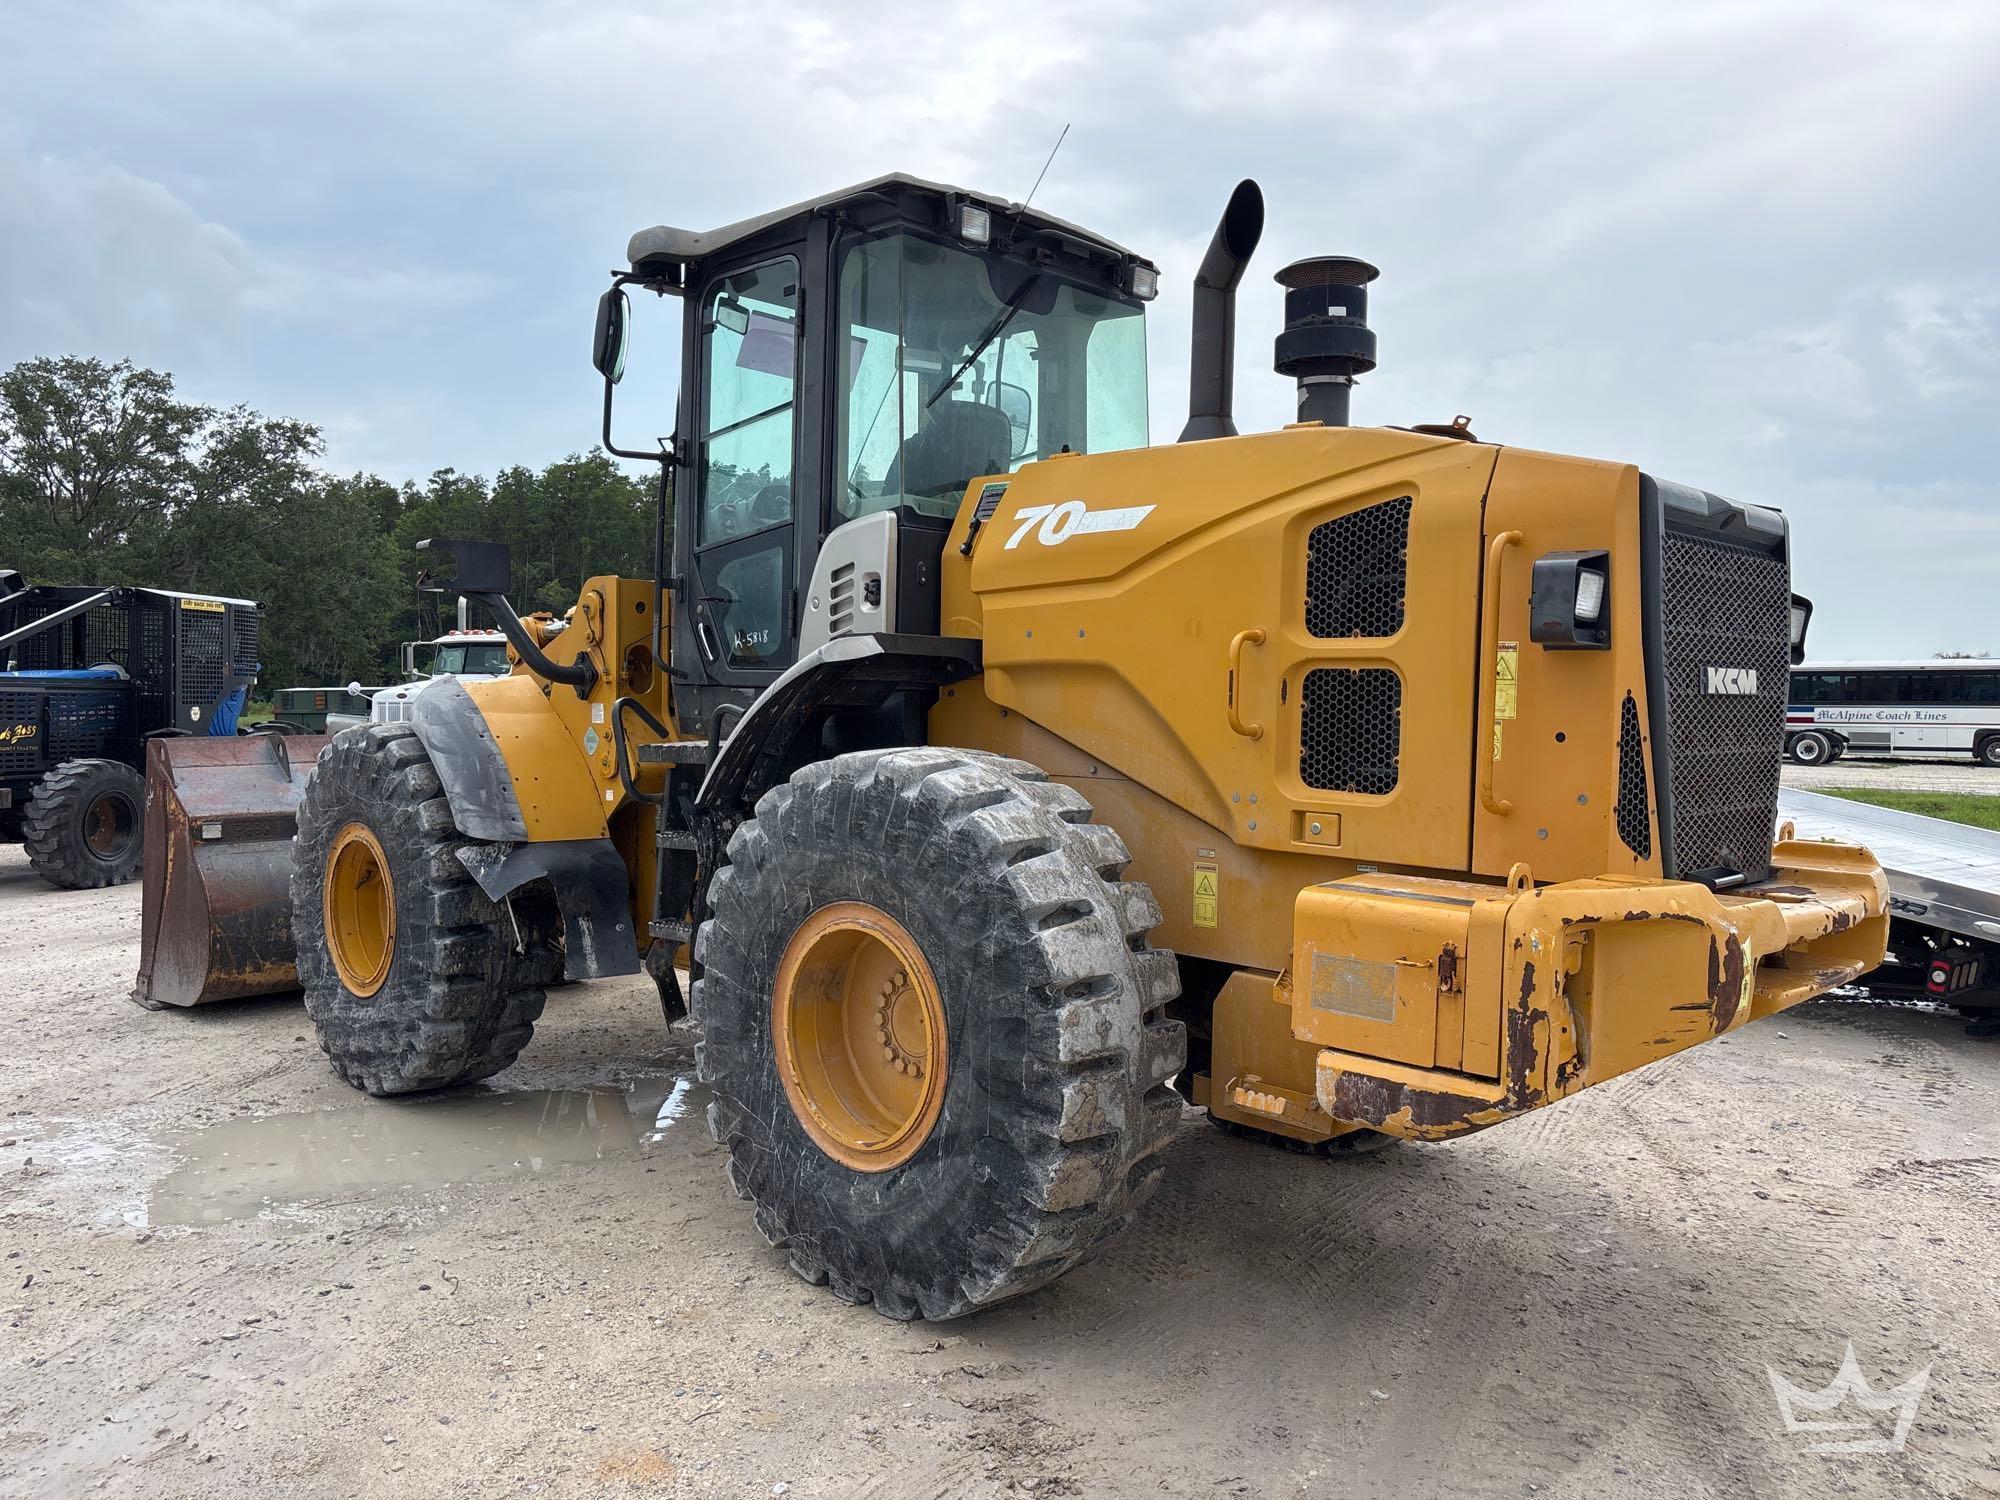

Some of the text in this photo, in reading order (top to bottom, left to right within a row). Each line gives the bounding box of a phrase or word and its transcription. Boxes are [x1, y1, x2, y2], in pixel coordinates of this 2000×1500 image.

[1003, 500, 1087, 550] 70
[734, 629, 769, 649] K-5818
[1707, 667, 1757, 695] KCM
[1816, 709, 1948, 722] McAlpine Coach Lines
